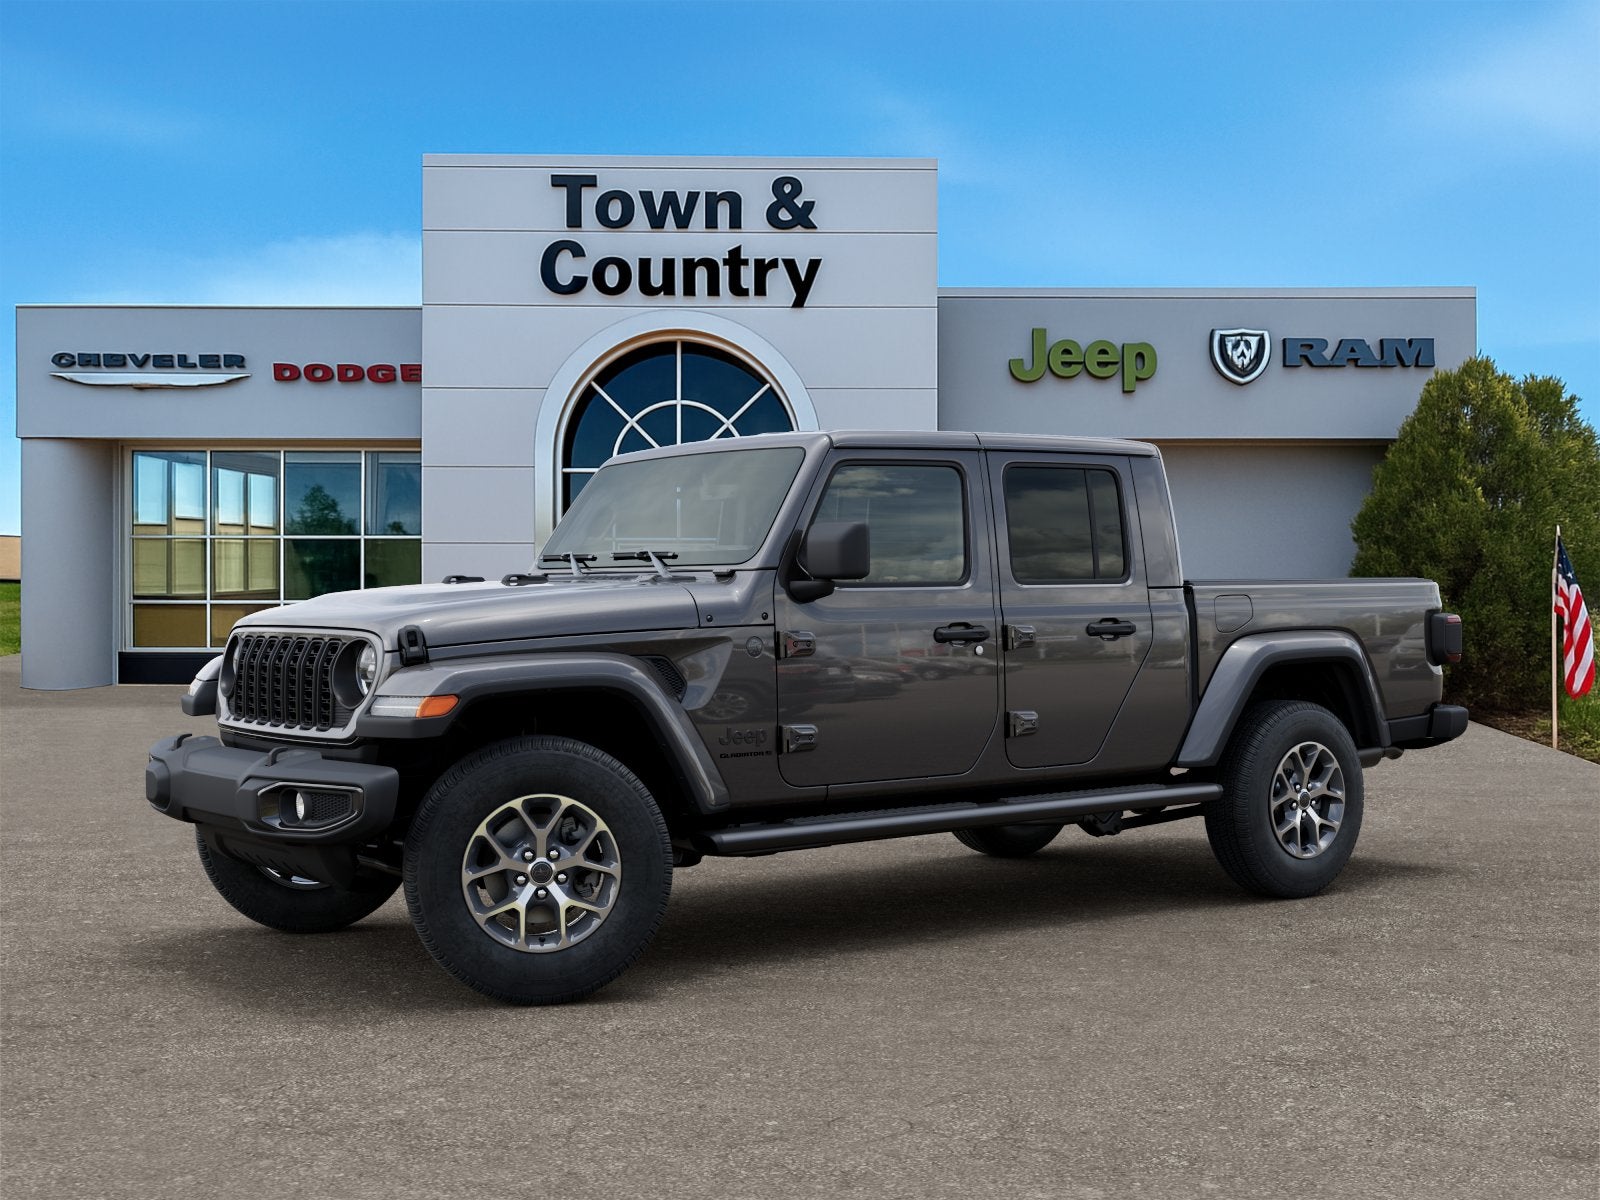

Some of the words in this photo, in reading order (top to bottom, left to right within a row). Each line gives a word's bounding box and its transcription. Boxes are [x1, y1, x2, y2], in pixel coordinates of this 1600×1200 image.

[550, 174, 742, 229] Town
[766, 176, 817, 230] &
[540, 239, 822, 308] Country
[273, 363, 422, 383] DODGE
[1009, 328, 1157, 392] Jeep
[1282, 337, 1436, 367] RAM
[718, 727, 768, 747] Jeep
